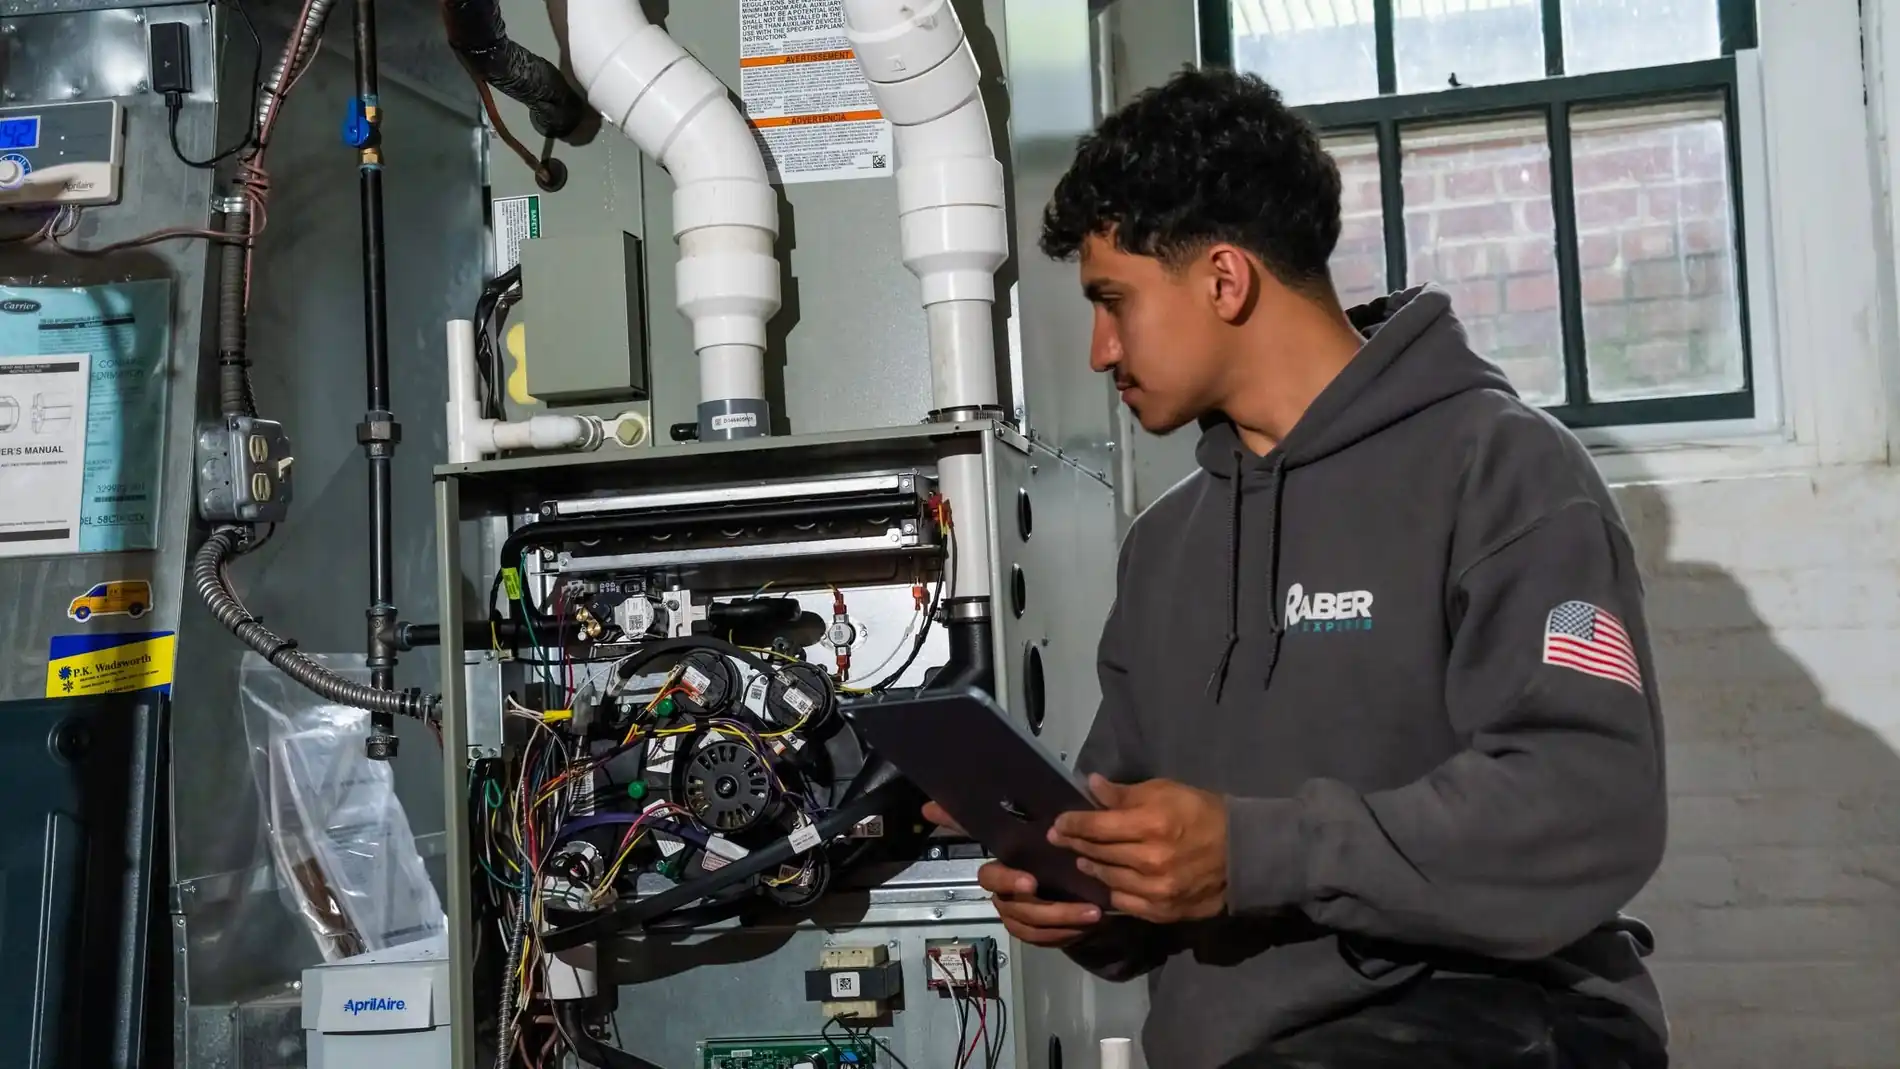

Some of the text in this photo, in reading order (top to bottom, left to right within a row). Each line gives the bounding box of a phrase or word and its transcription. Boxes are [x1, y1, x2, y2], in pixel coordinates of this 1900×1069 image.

[810, 0, 841, 8] AUXILIARY
[742, 12, 763, 20] WHICH
[793, 7, 827, 15] POTENTIAL
[787, 13, 821, 21] INSTALLED
[782, 19, 815, 28] AUXILIARY
[815, 17, 842, 25] DEVICES
[742, 29, 755, 37] USE
[755, 28, 773, 36] WITH
[786, 24, 814, 33] SPECIFIC
[814, 22, 845, 31] APPLIANC
[786, 52, 849, 62] AVERTISSEMENT
[791, 113, 847, 125] ADVERTENCIA
[530, 209, 539, 235] SAFETY
[3, 302, 37, 311] Carrier
[0, 445, 64, 456] ER'S MANUAL
[1284, 582, 1374, 630] RABER
[73, 666, 93, 678] P.K.
[95, 653, 152, 673] Wadsworth
[343, 997, 405, 1016] AprilAire
